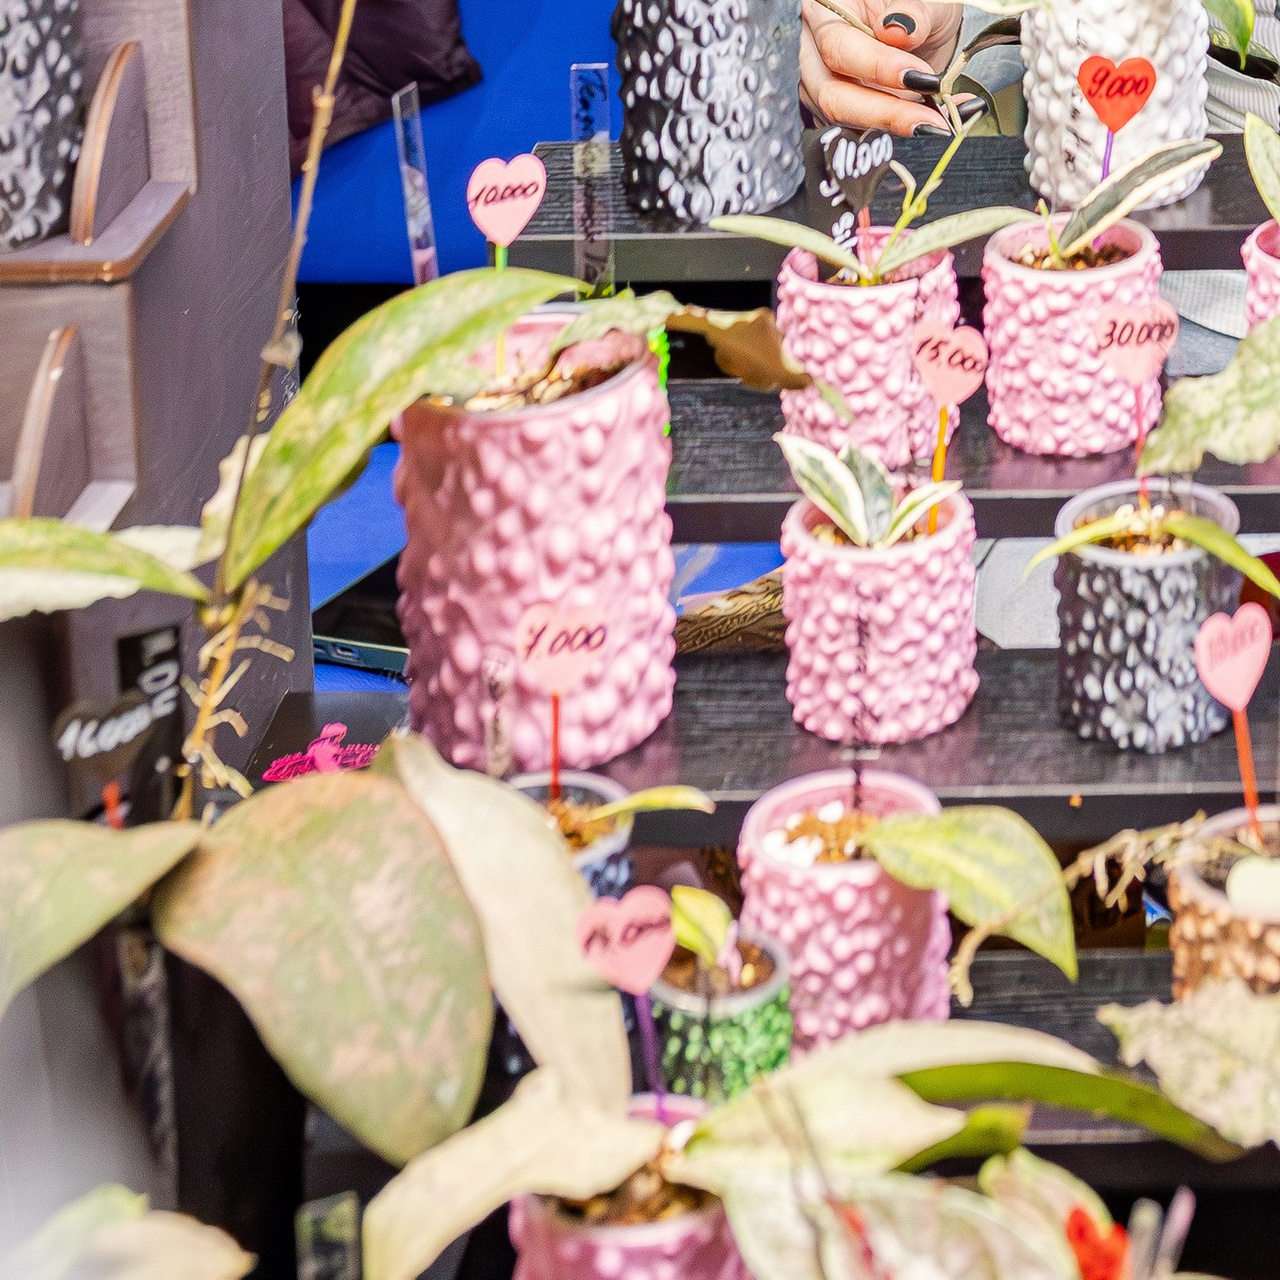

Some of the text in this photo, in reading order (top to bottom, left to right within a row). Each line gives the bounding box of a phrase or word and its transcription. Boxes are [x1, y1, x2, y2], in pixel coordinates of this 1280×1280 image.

[1087, 66, 1149, 99] 9.000
[832, 133, 894, 180] 11.000
[467, 182, 540, 209] 10.000
